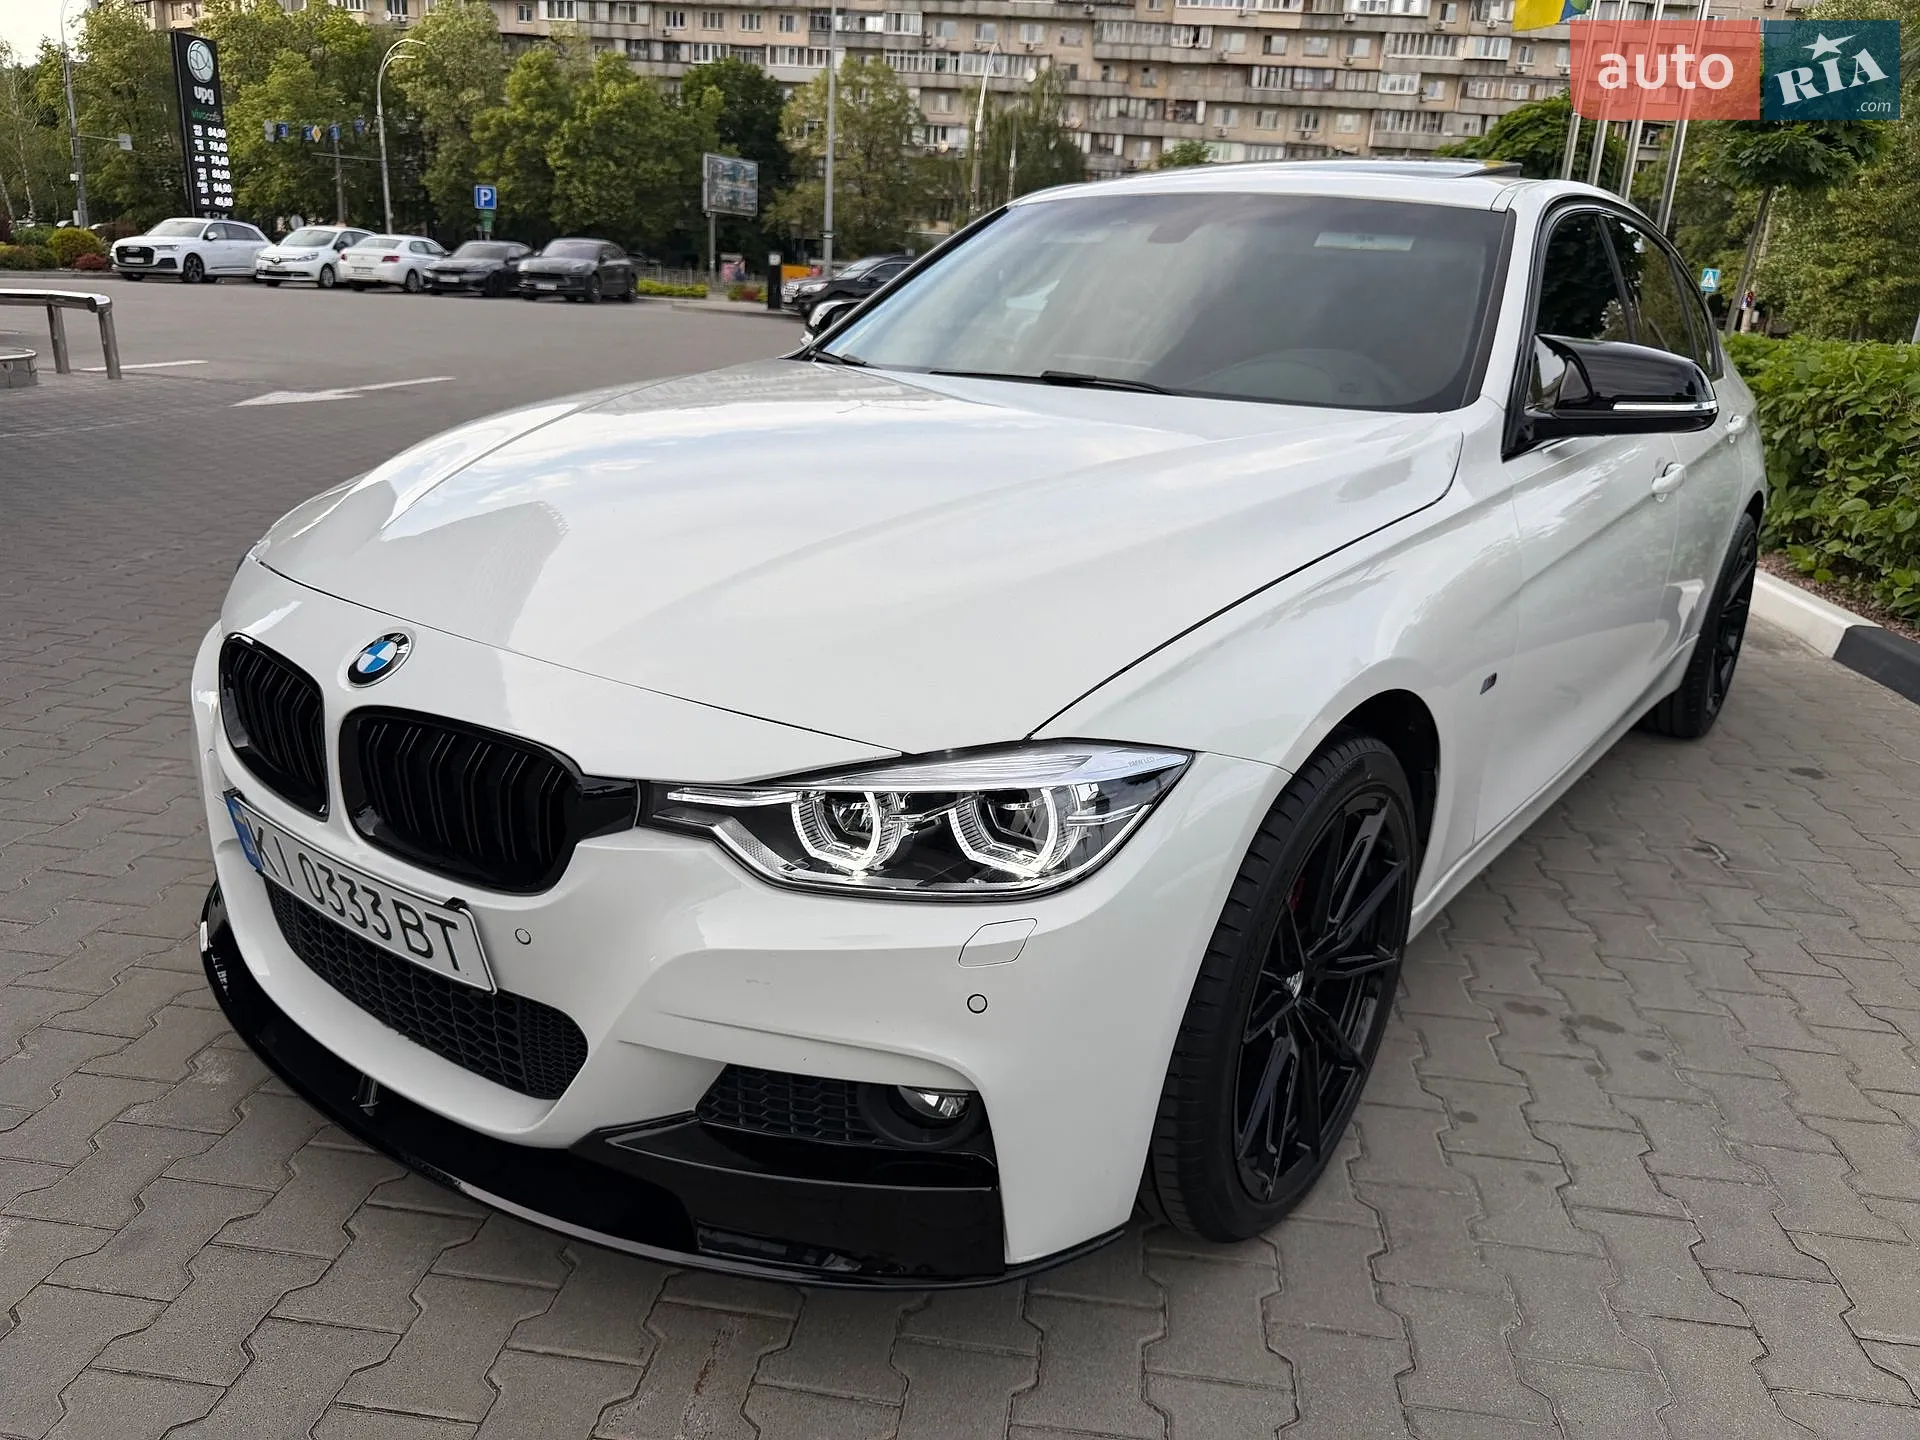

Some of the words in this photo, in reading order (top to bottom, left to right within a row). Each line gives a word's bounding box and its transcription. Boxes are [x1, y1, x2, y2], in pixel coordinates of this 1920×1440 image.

[193, 86, 215, 105] upg
[480, 189, 492, 207] P
[246, 817, 295, 887] KI
[298, 852, 392, 941] 0333
[391, 898, 461, 971] BT
